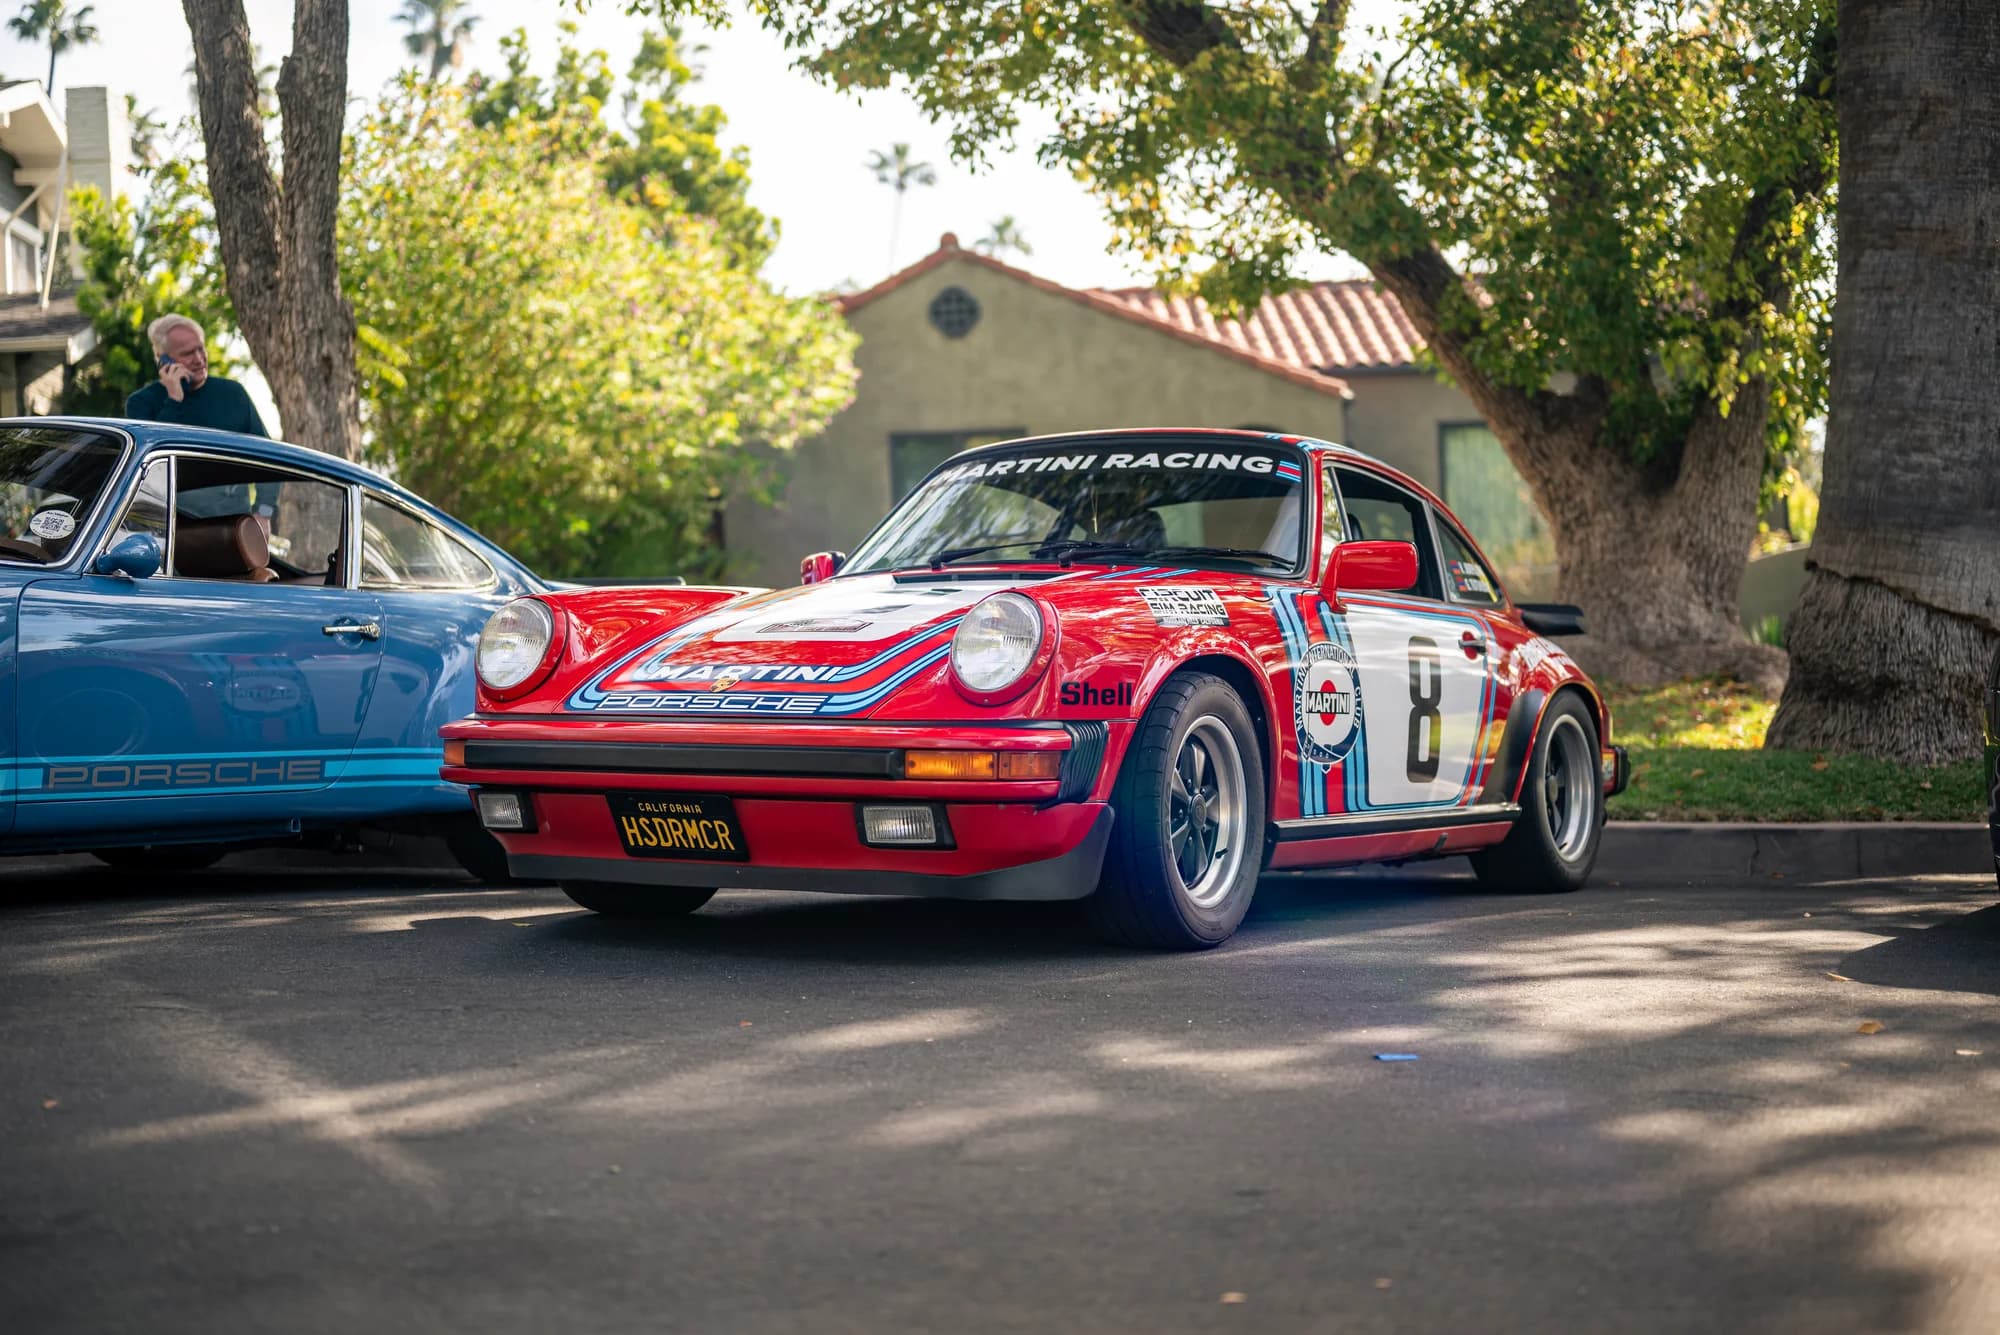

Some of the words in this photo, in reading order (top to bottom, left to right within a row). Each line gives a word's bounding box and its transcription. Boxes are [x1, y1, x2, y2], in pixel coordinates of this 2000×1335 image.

[944, 454, 1098, 482] MARTINI
[1102, 452, 1274, 473] RACING
[1139, 588, 1213, 602] CIRCUIT
[1150, 602, 1178, 615] SIM
[1178, 603, 1226, 616] RACING
[653, 665, 840, 682] MARTINI
[596, 694, 827, 712] PORSCHE
[1061, 681, 1133, 706] Shell
[1306, 692, 1350, 714] MARTINI
[1354, 686, 1362, 729] CLUB
[1406, 635, 1442, 784] 8
[48, 760, 321, 789] PORSCHE
[638, 802, 703, 814] CALIFORNIA
[621, 816, 736, 851] HSDRMCR
